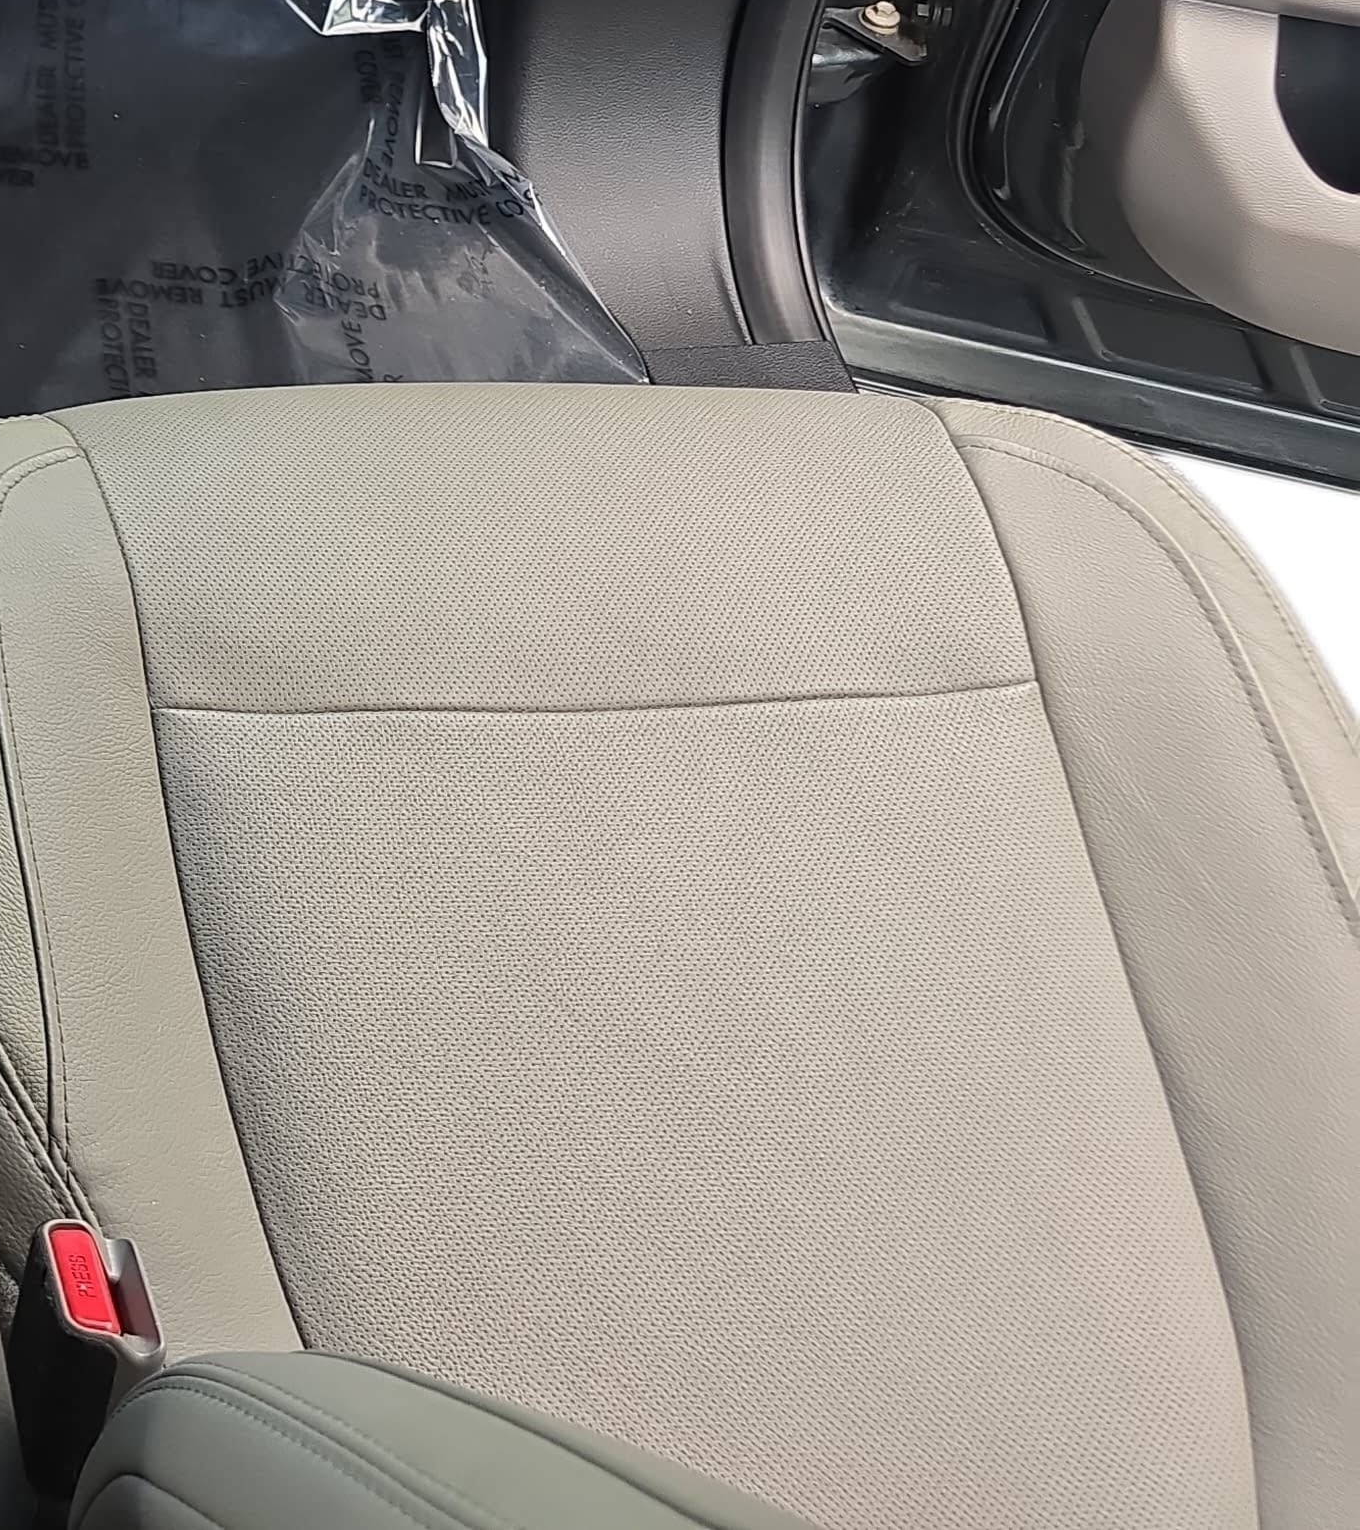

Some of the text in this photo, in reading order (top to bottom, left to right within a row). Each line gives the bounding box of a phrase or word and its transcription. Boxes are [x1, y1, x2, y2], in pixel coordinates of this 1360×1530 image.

[358, 184, 490, 227] PROTECTIVE
[152, 260, 237, 288] COVER
[126, 301, 159, 380] DEALER
